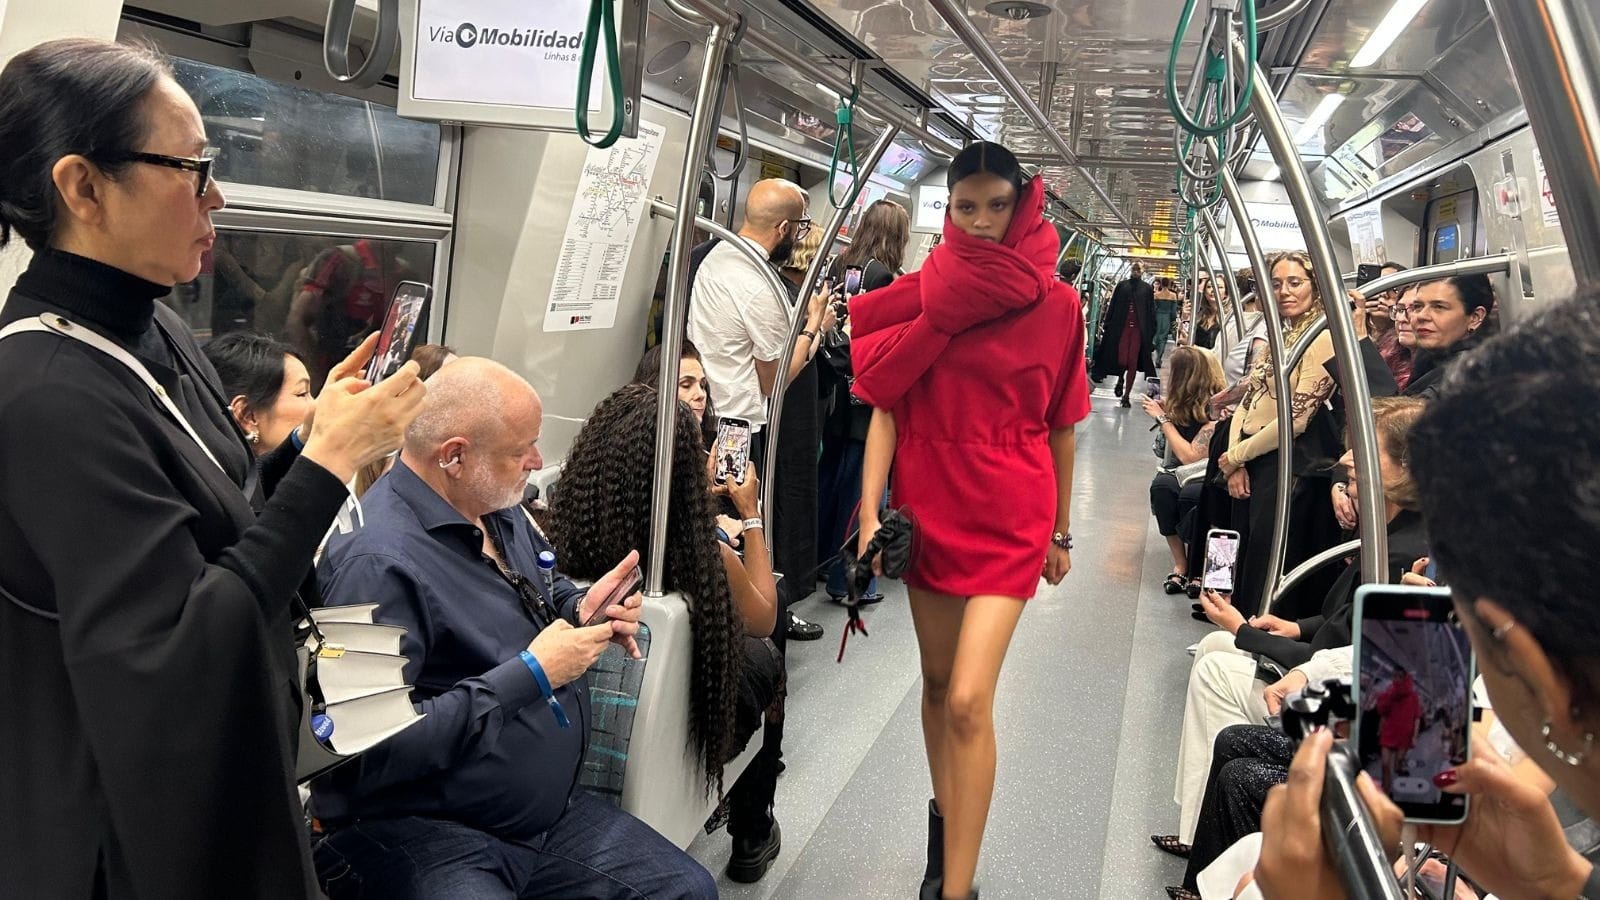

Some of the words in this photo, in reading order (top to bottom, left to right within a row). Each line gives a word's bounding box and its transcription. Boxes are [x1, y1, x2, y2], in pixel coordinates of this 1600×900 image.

[429, 26, 454, 43] Via
[479, 28, 584, 49] Mobilidad
[544, 52, 569, 61] Linhas
[571, 53, 577, 61] 8
